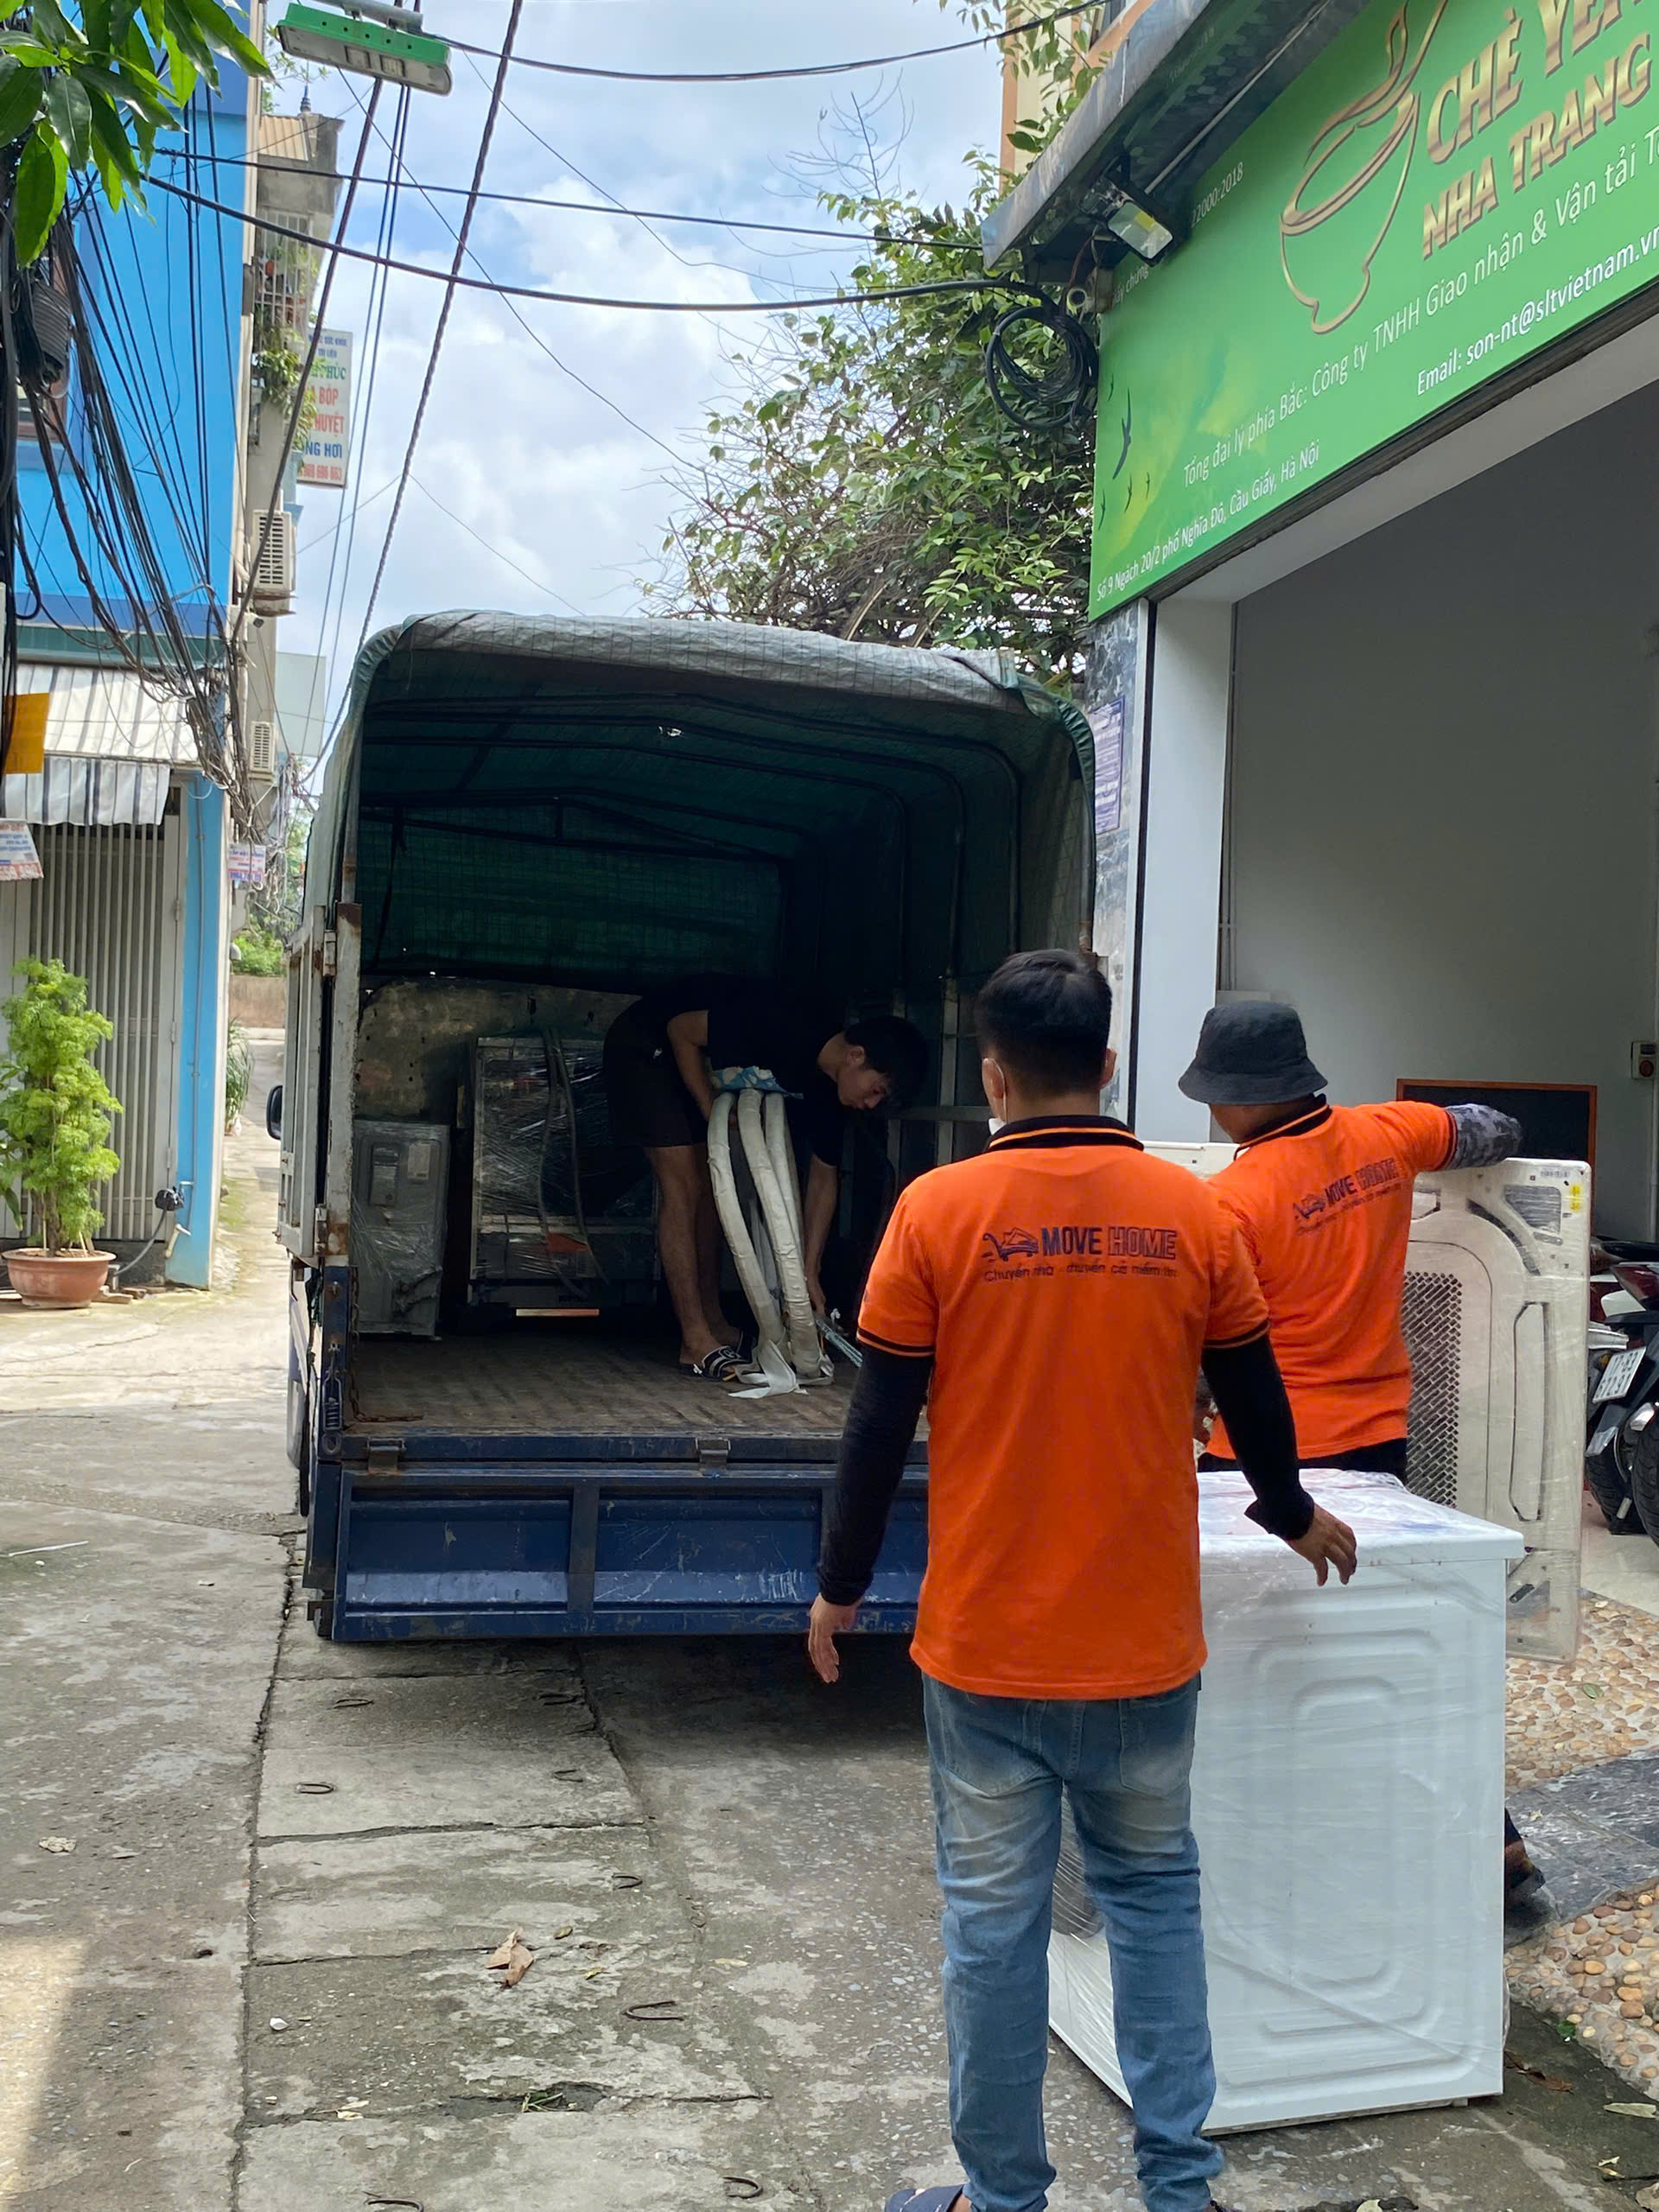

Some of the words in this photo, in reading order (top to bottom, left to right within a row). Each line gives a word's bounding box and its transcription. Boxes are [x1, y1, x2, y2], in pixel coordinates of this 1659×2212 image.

[1422, 155, 1499, 261] NHA
[1507, 32, 1651, 194] TRANG
[1184, 454, 1210, 487] Tổng
[1212, 434, 1230, 467] đại
[1234, 424, 1245, 456] lý
[1248, 404, 1275, 449] phía
[1279, 379, 1307, 421] Bắc:
[1312, 355, 1349, 397] Công
[1353, 340, 1369, 372] ty
[1373, 296, 1420, 353] TNHH
[1426, 271, 1468, 317] Giao
[1474, 232, 1523, 285] nhận
[1530, 208, 1548, 245] &
[1555, 181, 1597, 226] Vận
[1605, 142, 1637, 194] tải
[1417, 346, 1462, 396] Email:
[1096, 576, 1107, 601] Số
[1108, 575, 1114, 594] 9
[1141, 544, 1160, 575] 20/2
[1161, 530, 1180, 565] phố
[1181, 516, 1208, 549] Nghĩa
[1230, 488, 1249, 516] Cầu
[1252, 467, 1277, 501] Giấy,
[1281, 455, 1296, 483] Hà
[1299, 438, 1319, 472] Nội
[1041, 1226, 1103, 1256] MOVE
[1108, 1226, 1178, 1260] HOME
